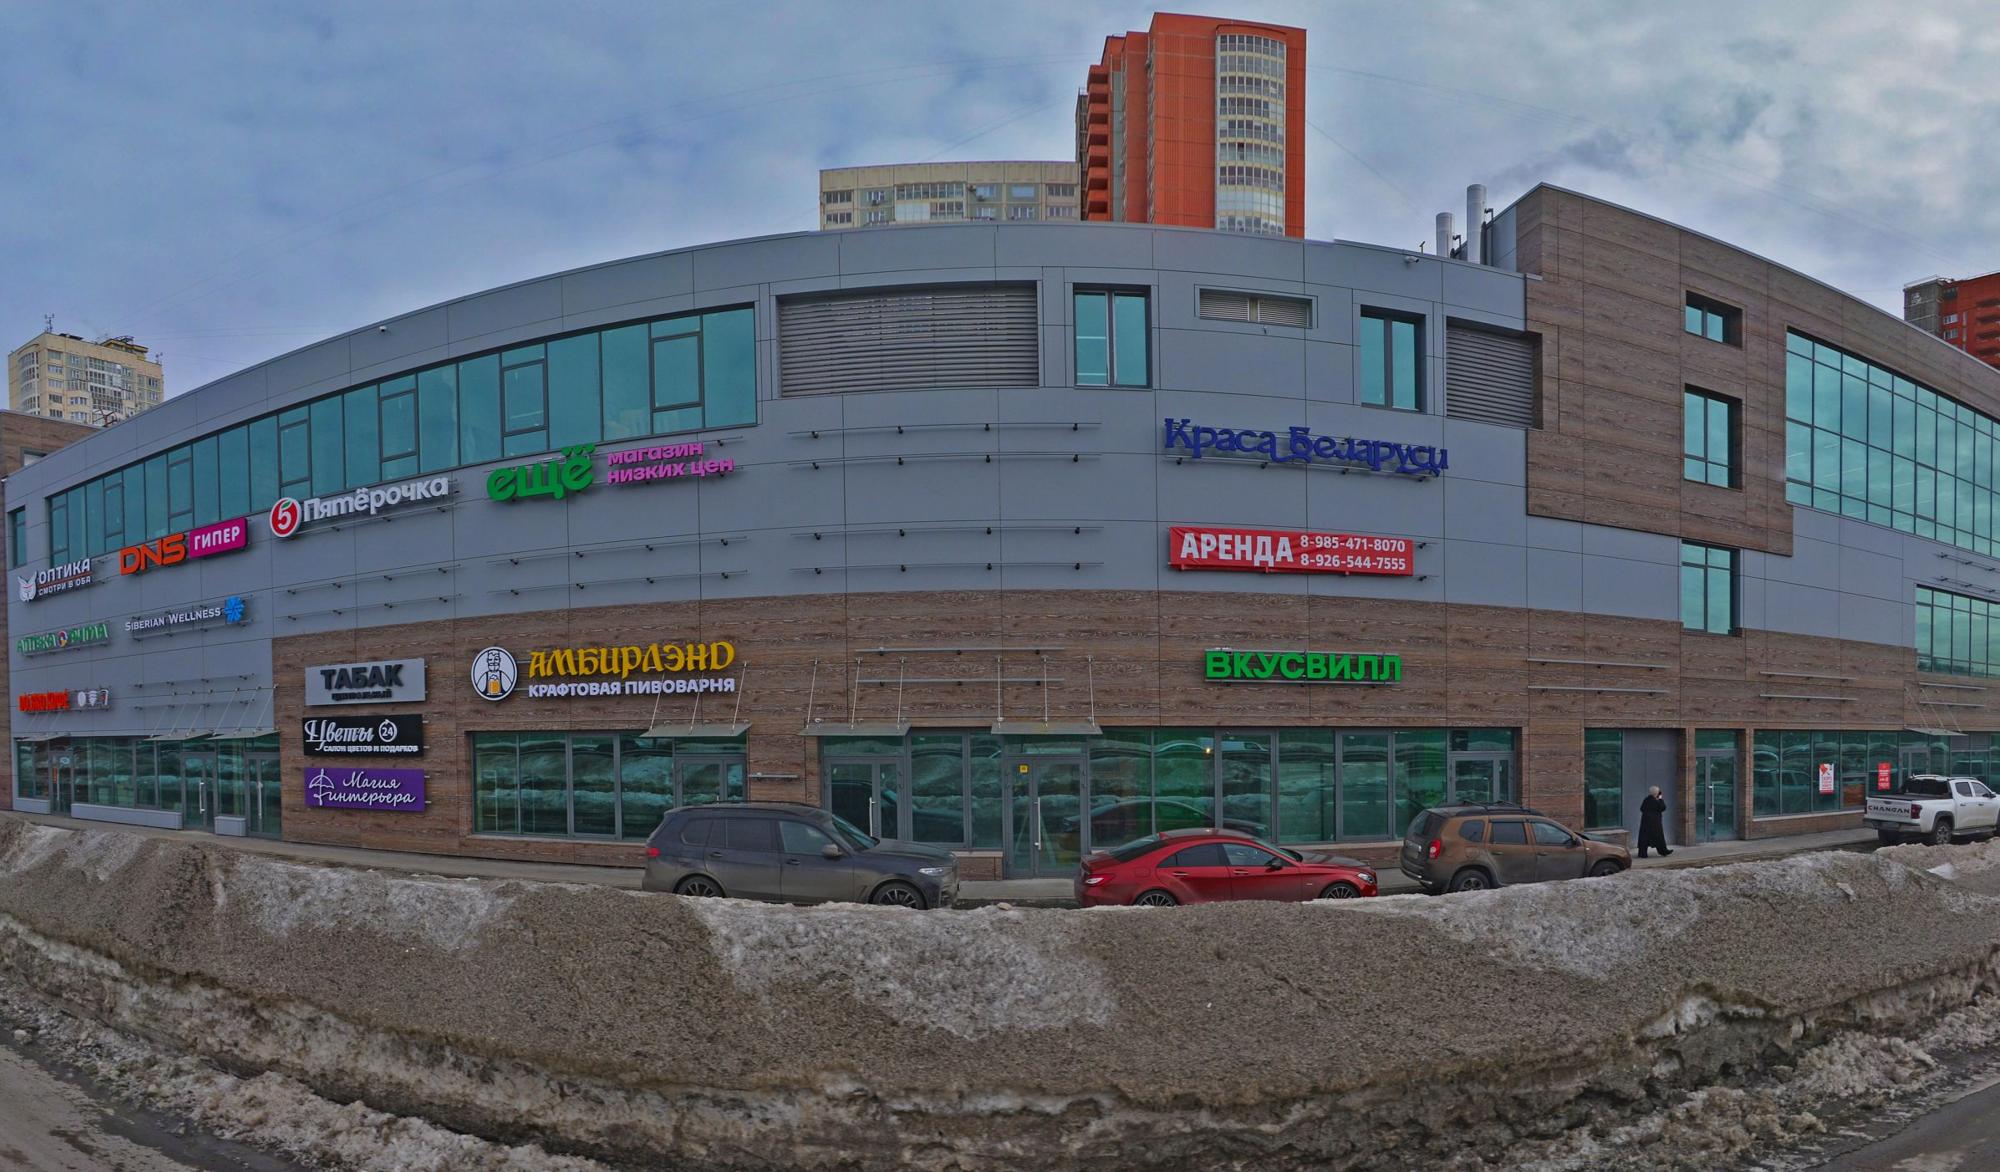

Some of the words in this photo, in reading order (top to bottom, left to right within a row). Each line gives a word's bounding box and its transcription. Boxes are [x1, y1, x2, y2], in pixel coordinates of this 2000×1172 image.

[607, 441, 704, 466] магазин
[1164, 417, 1280, 460] Краса
[1288, 425, 1449, 477] Беларуси
[486, 443, 597, 502] ещё
[607, 462, 686, 484] низких
[690, 456, 735, 479] цен
[301, 476, 449, 521] Пятёрочка
[193, 525, 241, 551] ГИПЕР
[1180, 532, 1294, 567] АРЕНДА
[1300, 535, 1406, 553] 8-985-471-8070
[119, 533, 186, 576] DNS
[1300, 554, 1406, 571] 8-926-544-7555
[38, 558, 91, 584] ОПТИКА
[38, 584, 66, 596] СМОТРИ
[75, 576, 91, 586] ОБА
[124, 616, 165, 632] SIBERIAN
[168, 607, 221, 624] WELLNESS
[529, 641, 736, 679] АМБИРЛЭНД
[1205, 651, 1402, 682] ВКУСВИЛЛ
[320, 663, 405, 691] ТАБАК
[528, 680, 621, 698] КРАФТОВАЯ
[626, 677, 736, 695] ПИВОВАРНЯ
[304, 719, 374, 750] Цветы
[380, 744, 419, 753] ПОДАРКОВ
[342, 771, 401, 789] Магия
[328, 791, 416, 807] интерьера
[1868, 805, 1911, 814] CHANGAN
